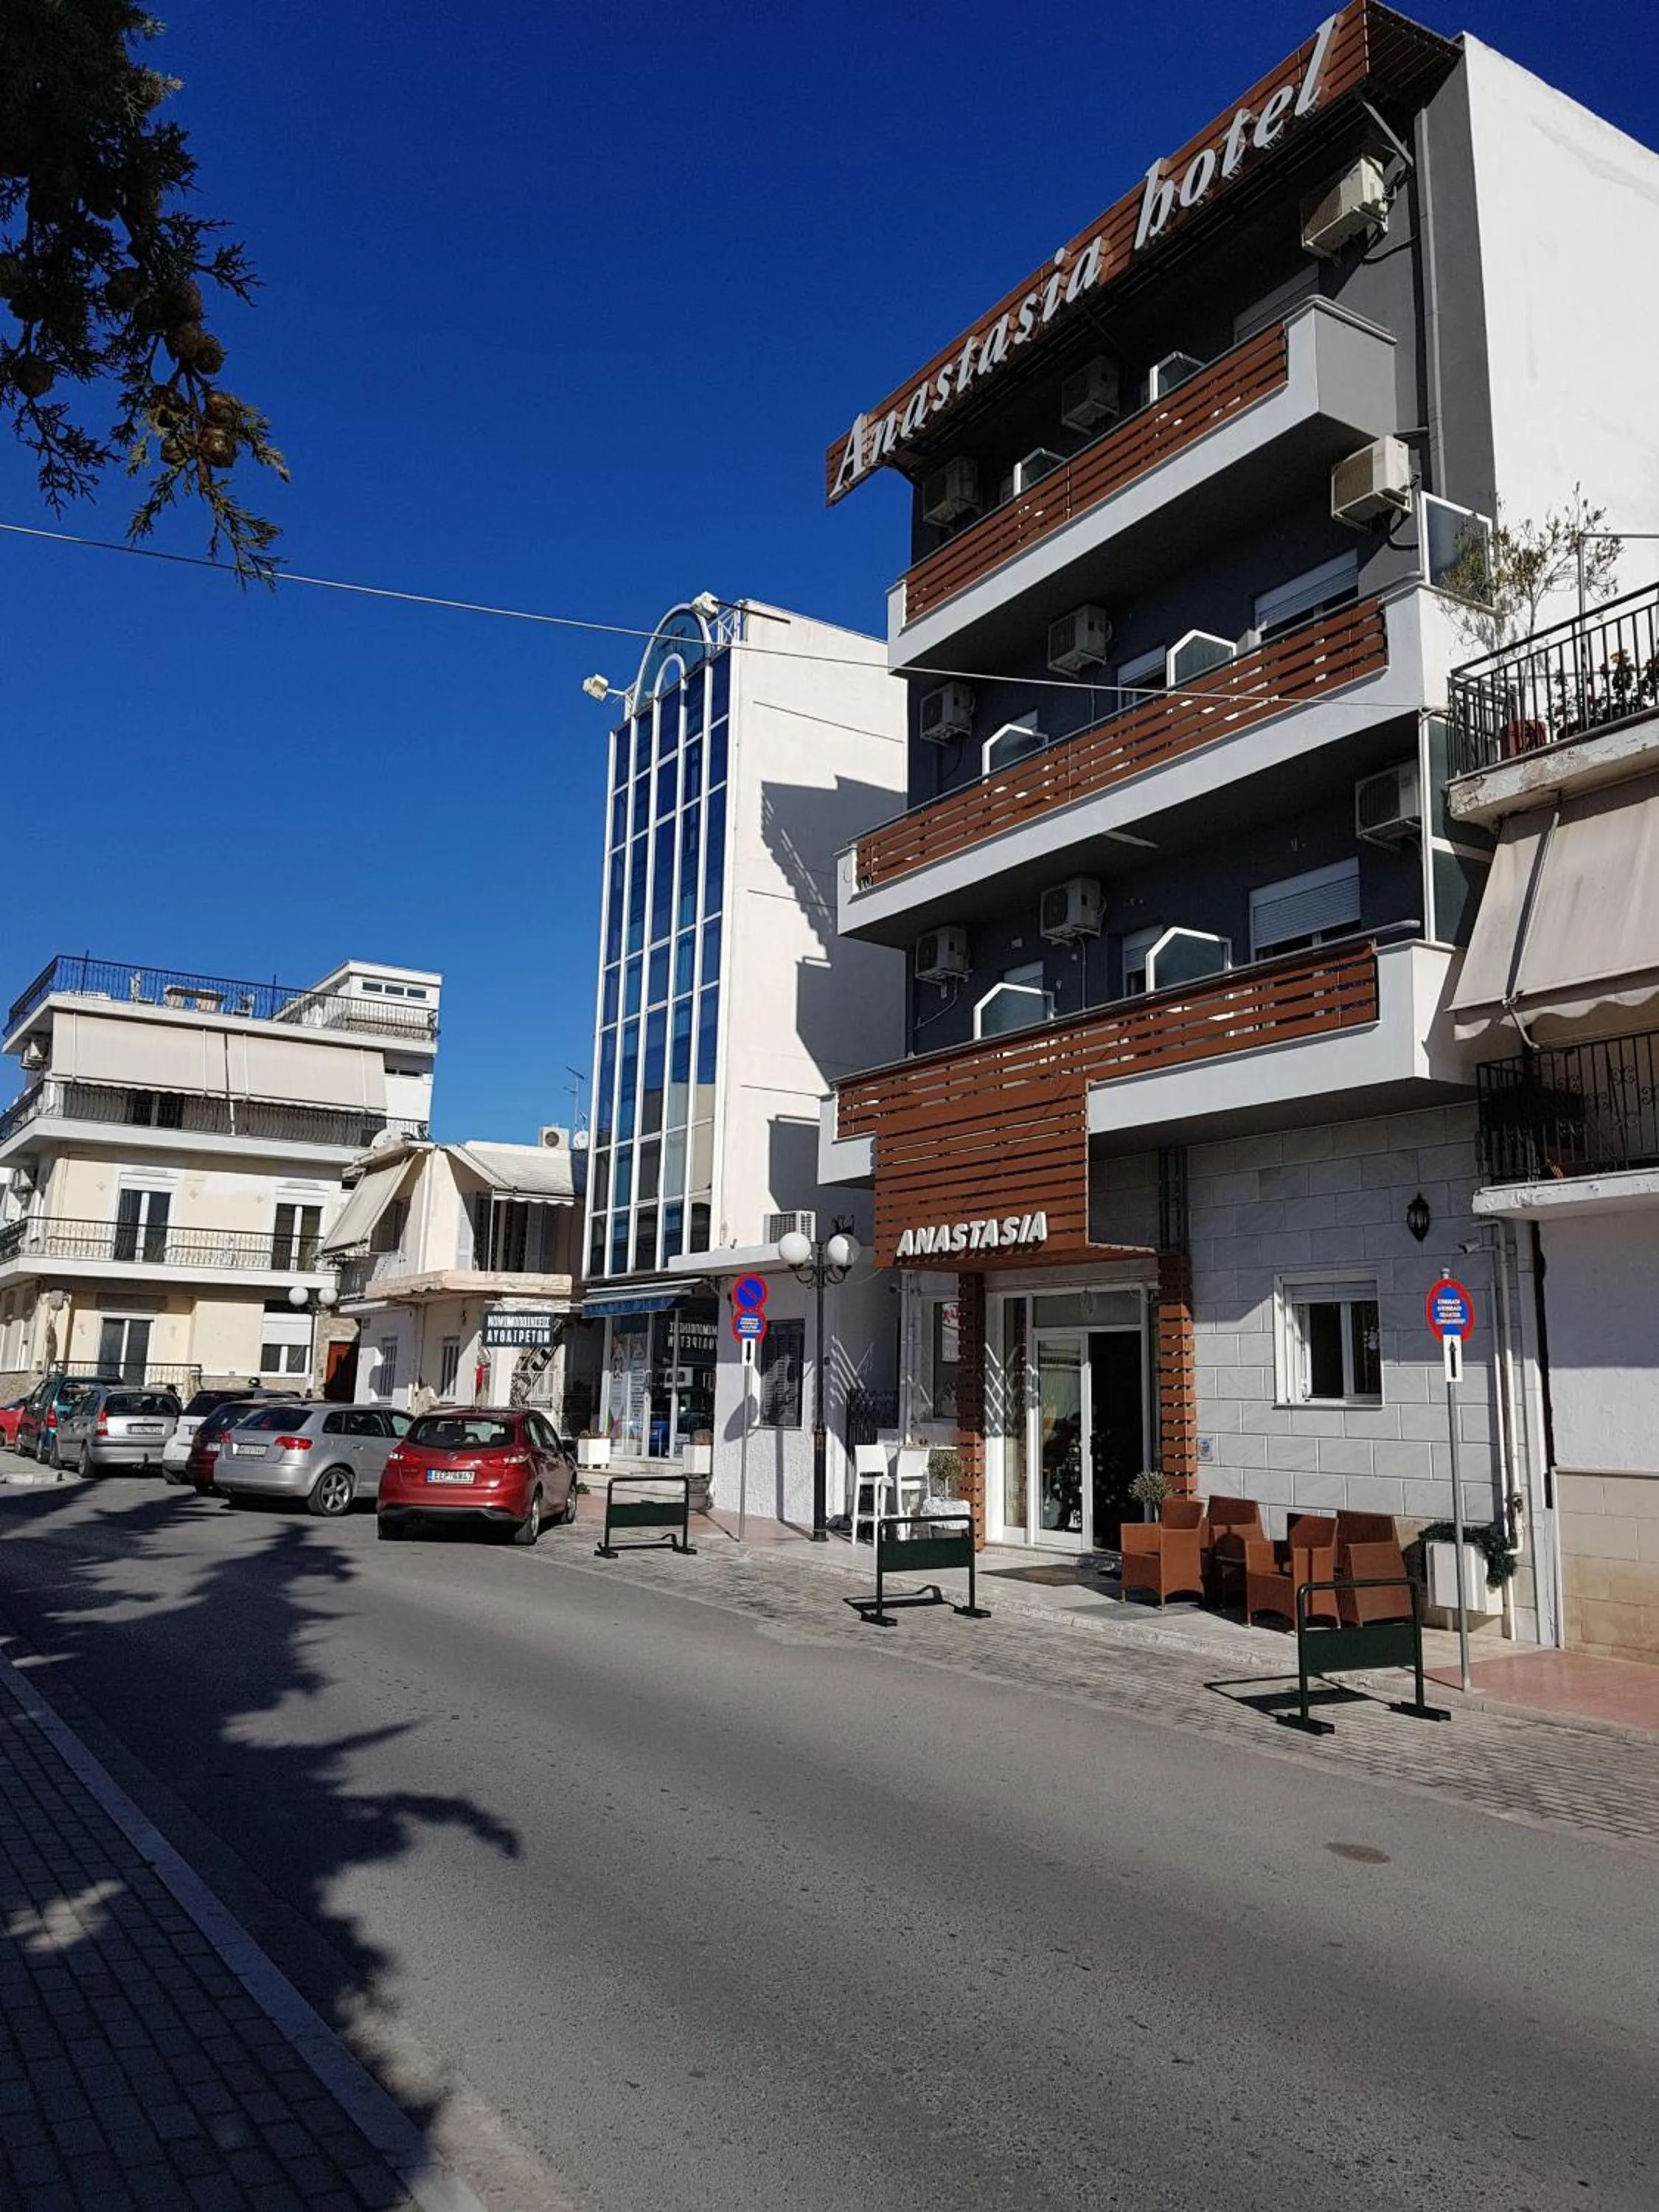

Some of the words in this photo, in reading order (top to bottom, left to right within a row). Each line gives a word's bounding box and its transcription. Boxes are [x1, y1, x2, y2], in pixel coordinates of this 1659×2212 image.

[830, 236, 1104, 498] Anastasia
[1134, 13, 1339, 251] hotel
[896, 1211, 1048, 1256] ANASTASIA
